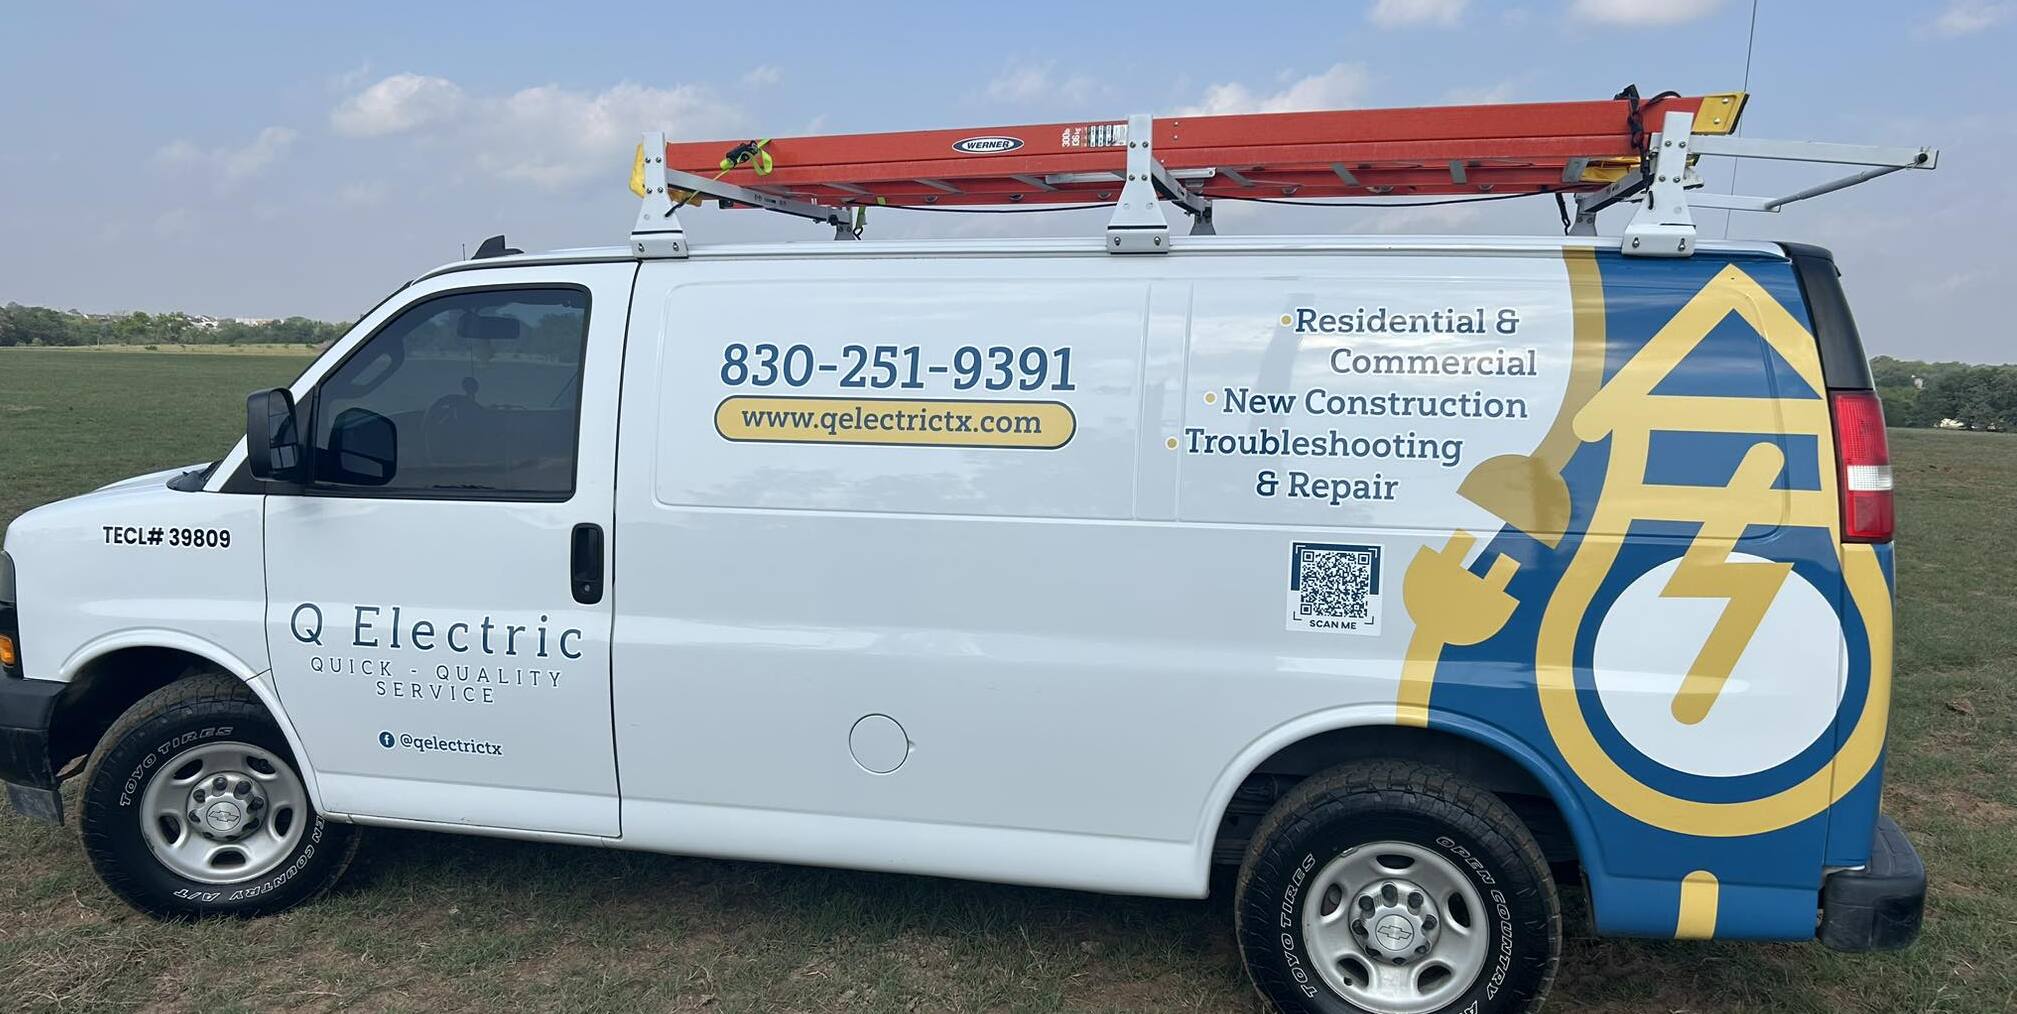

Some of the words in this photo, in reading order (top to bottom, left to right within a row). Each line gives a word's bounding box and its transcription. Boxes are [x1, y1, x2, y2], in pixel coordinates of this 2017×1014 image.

[967, 141, 1010, 149] WERNER
[1295, 308, 1486, 334] Residential
[1496, 308, 1520, 334] &
[720, 343, 1076, 391] 830-251-9391
[1330, 348, 1537, 376] Commercial
[1223, 388, 1297, 414] New
[1305, 389, 1528, 418] Construction
[742, 407, 1042, 434] www.qelectrictx.com
[1185, 428, 1463, 467] Troubleshooting
[1256, 470, 1279, 496] &
[1288, 472, 1399, 505] Repair
[103, 526, 164, 546] TECL#
[169, 528, 231, 548] 39809
[290, 602, 323, 646] Q
[353, 605, 582, 659] Electric
[1309, 619, 1339, 629] SCAN
[1341, 621, 1357, 630] ME
[310, 657, 392, 676] QUICK
[436, 665, 562, 687] QUALITY
[376, 681, 494, 703] SERVICE
[400, 733, 503, 756] @qelectrictx
[120, 753, 157, 807] TOYO
[158, 726, 234, 755] TIRES
[312, 815, 325, 844] EN
[229, 844, 315, 901] COUNTRY
[173, 888, 221, 902] A/T
[1280, 853, 1316, 928] TIRES
[1435, 836, 1496, 885] OPEN
[1486, 889, 1513, 1000] COUNTRY
[1281, 933, 1318, 998] TOYO
